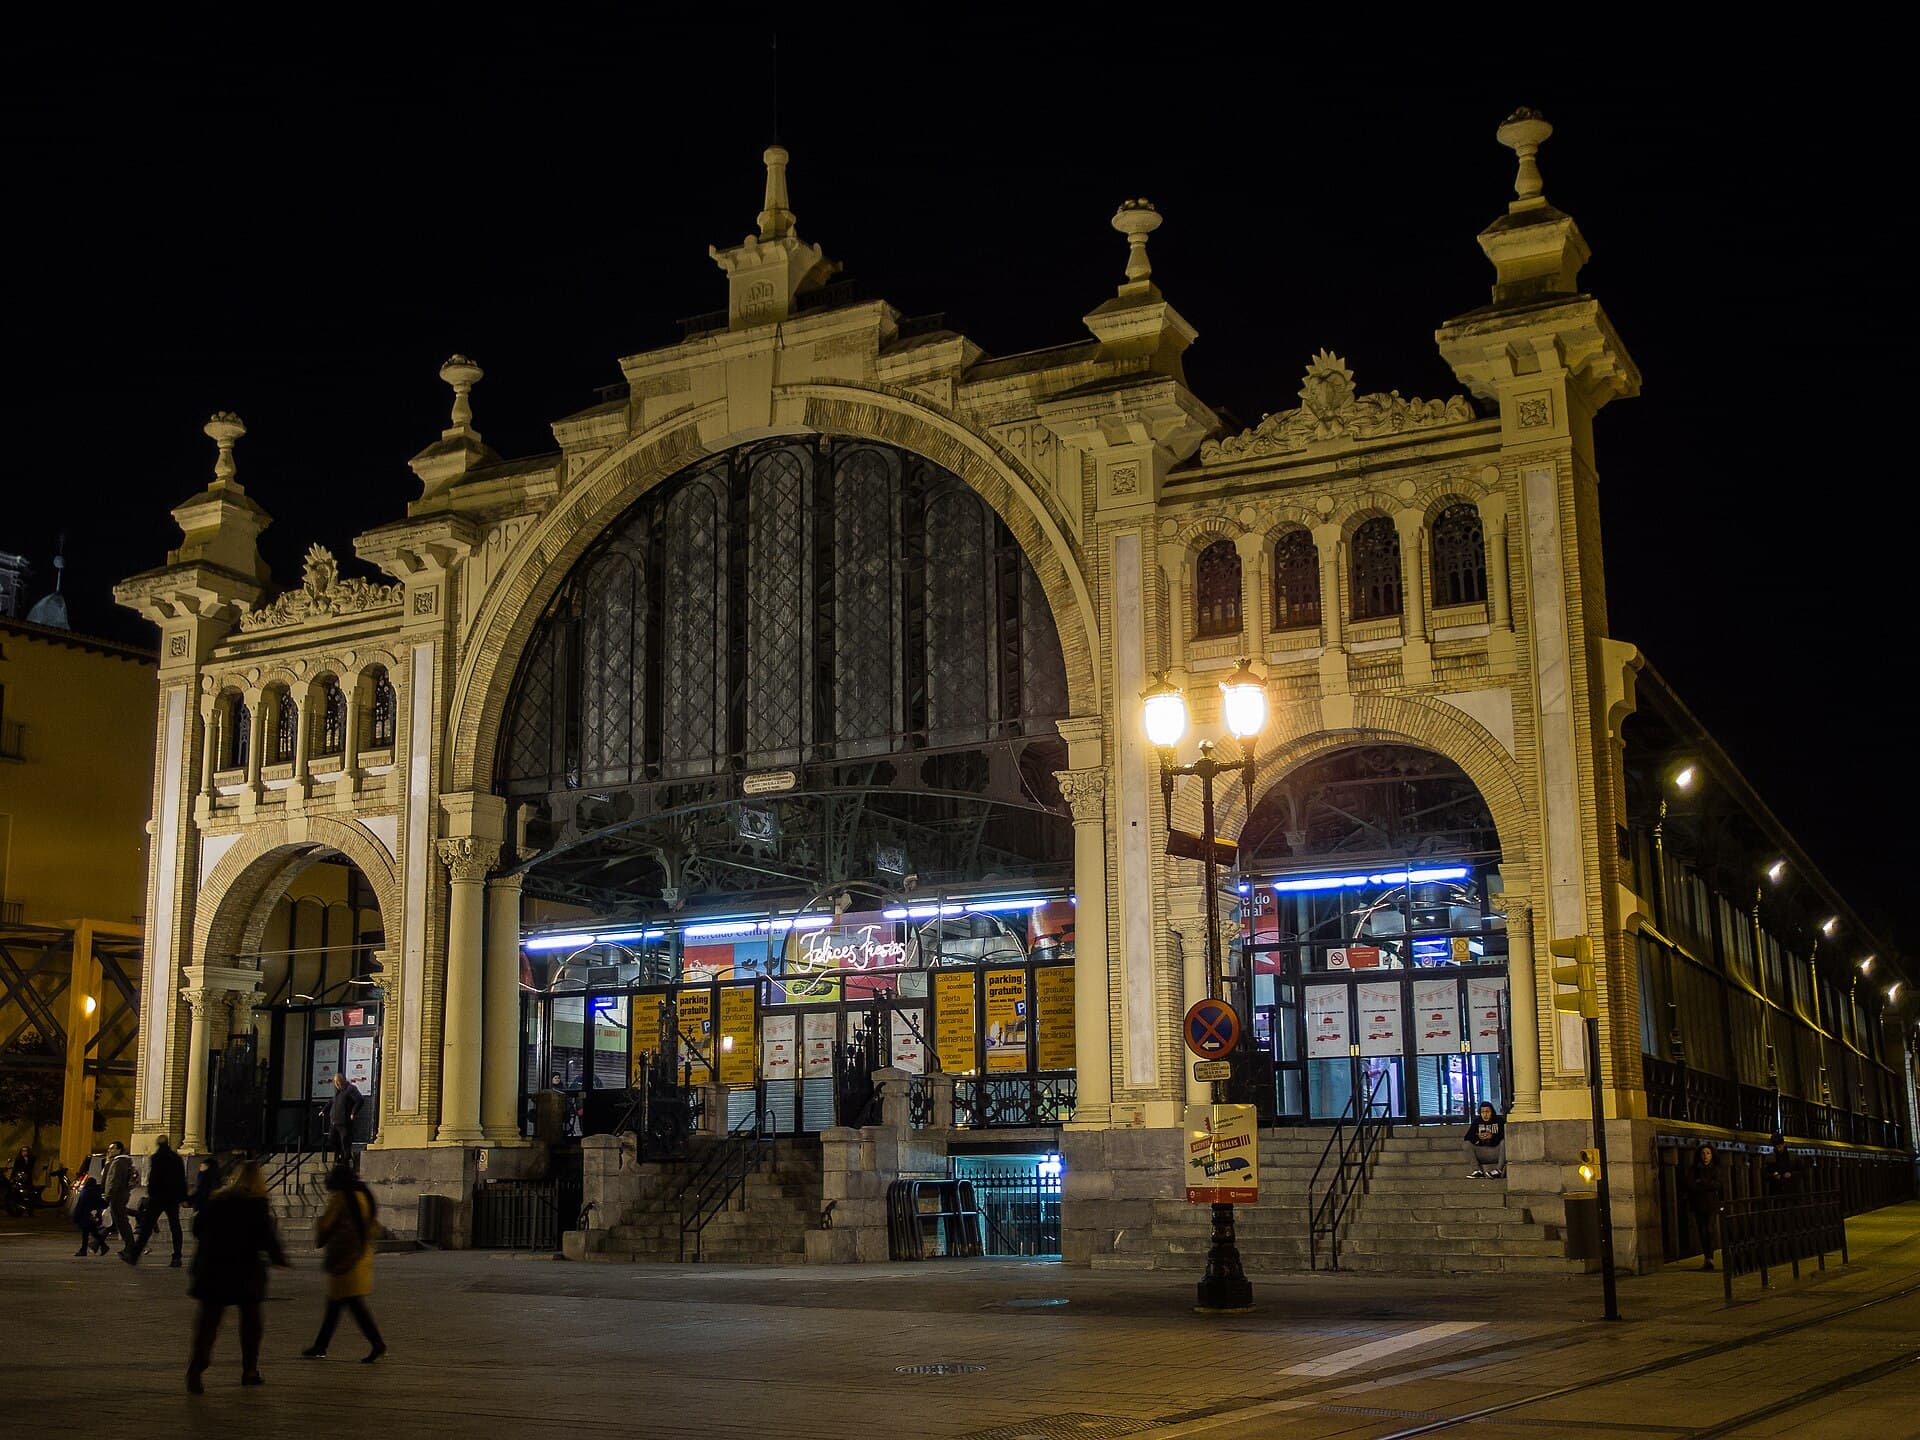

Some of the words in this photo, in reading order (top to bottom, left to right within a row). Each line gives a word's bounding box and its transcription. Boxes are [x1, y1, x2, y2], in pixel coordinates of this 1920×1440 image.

[797, 928, 857, 973] Felices
[853, 924, 906, 970] Fiestas
[989, 974, 1022, 986] parking
[989, 985, 1022, 998] gratuito
[680, 995, 709, 1006] parking
[680, 1006, 709, 1017] gratuito
[1018, 1002, 1025, 1013] P
[703, 1021, 711, 1032] P
